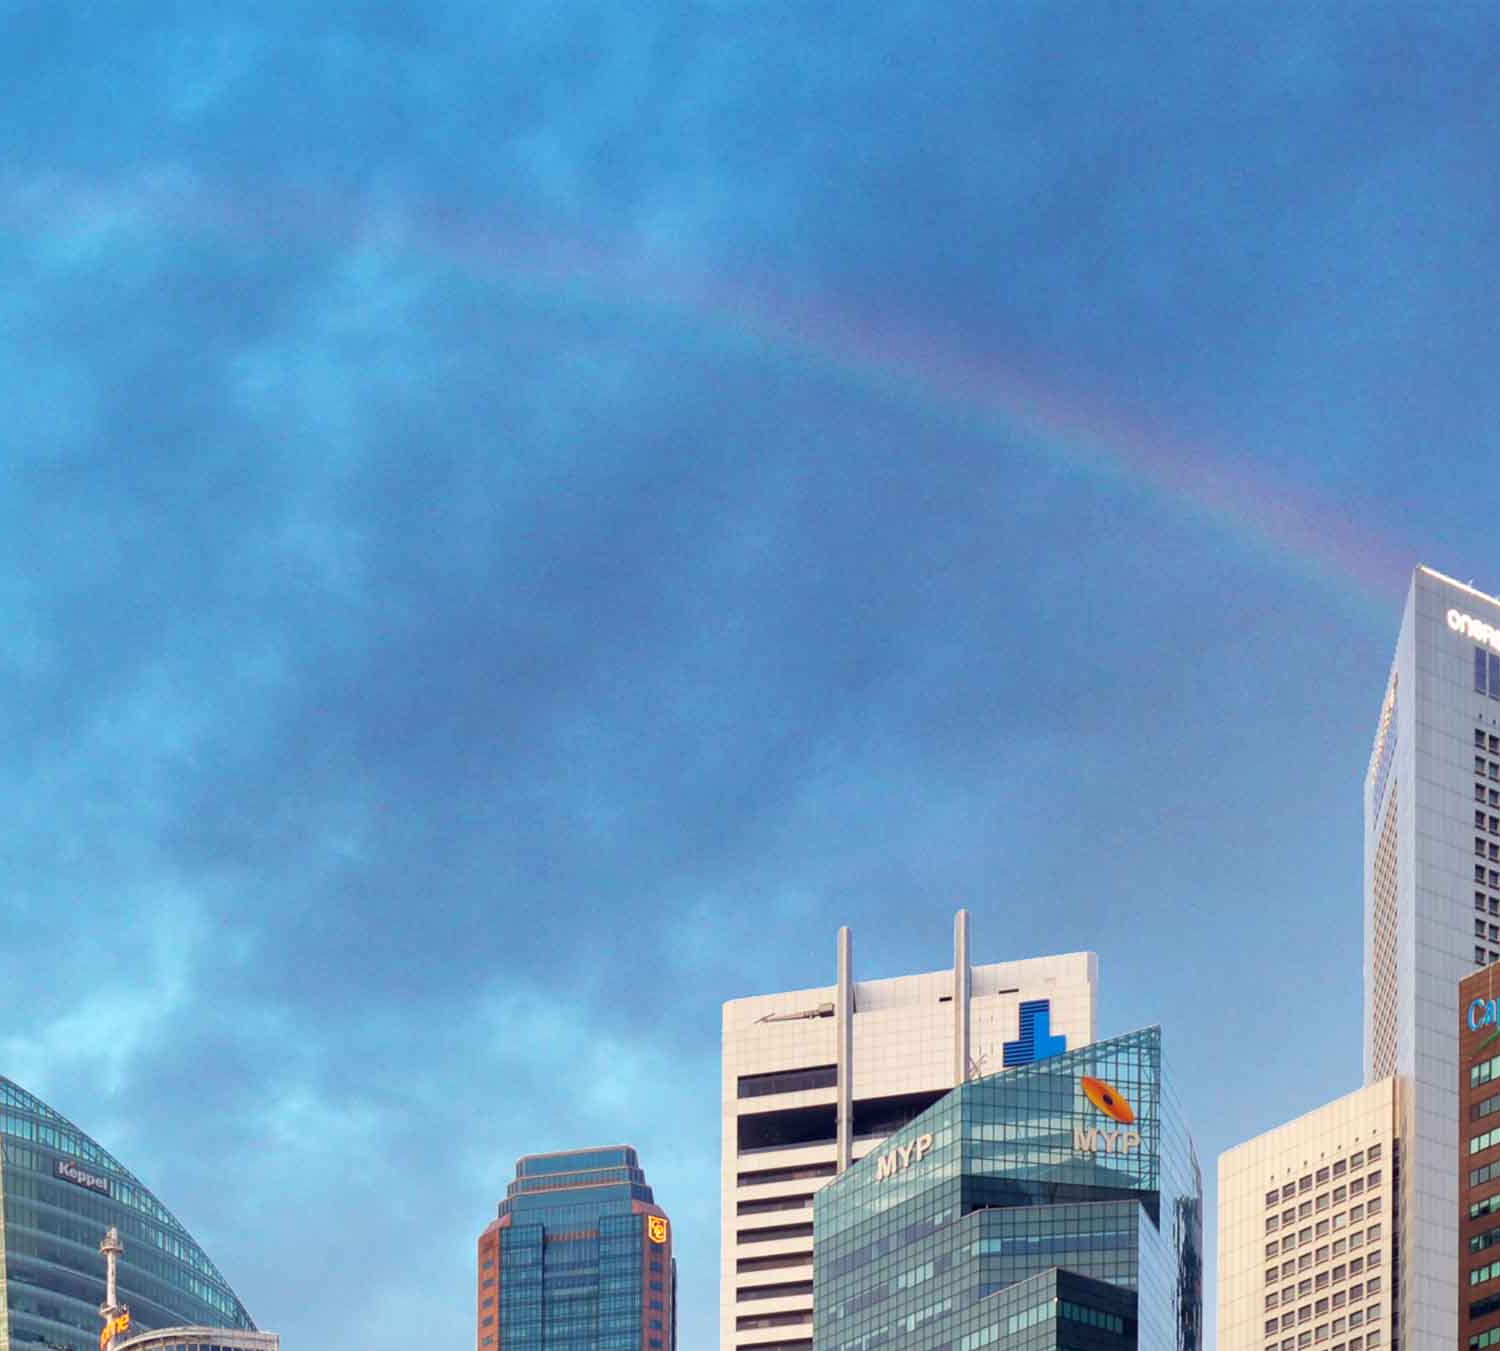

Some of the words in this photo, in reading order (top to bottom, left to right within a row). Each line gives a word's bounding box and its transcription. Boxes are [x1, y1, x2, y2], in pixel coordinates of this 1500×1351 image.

[1074, 1127, 1140, 1154] MYP
[873, 1133, 934, 1181] MYP
[58, 1160, 108, 1191] Keppel
